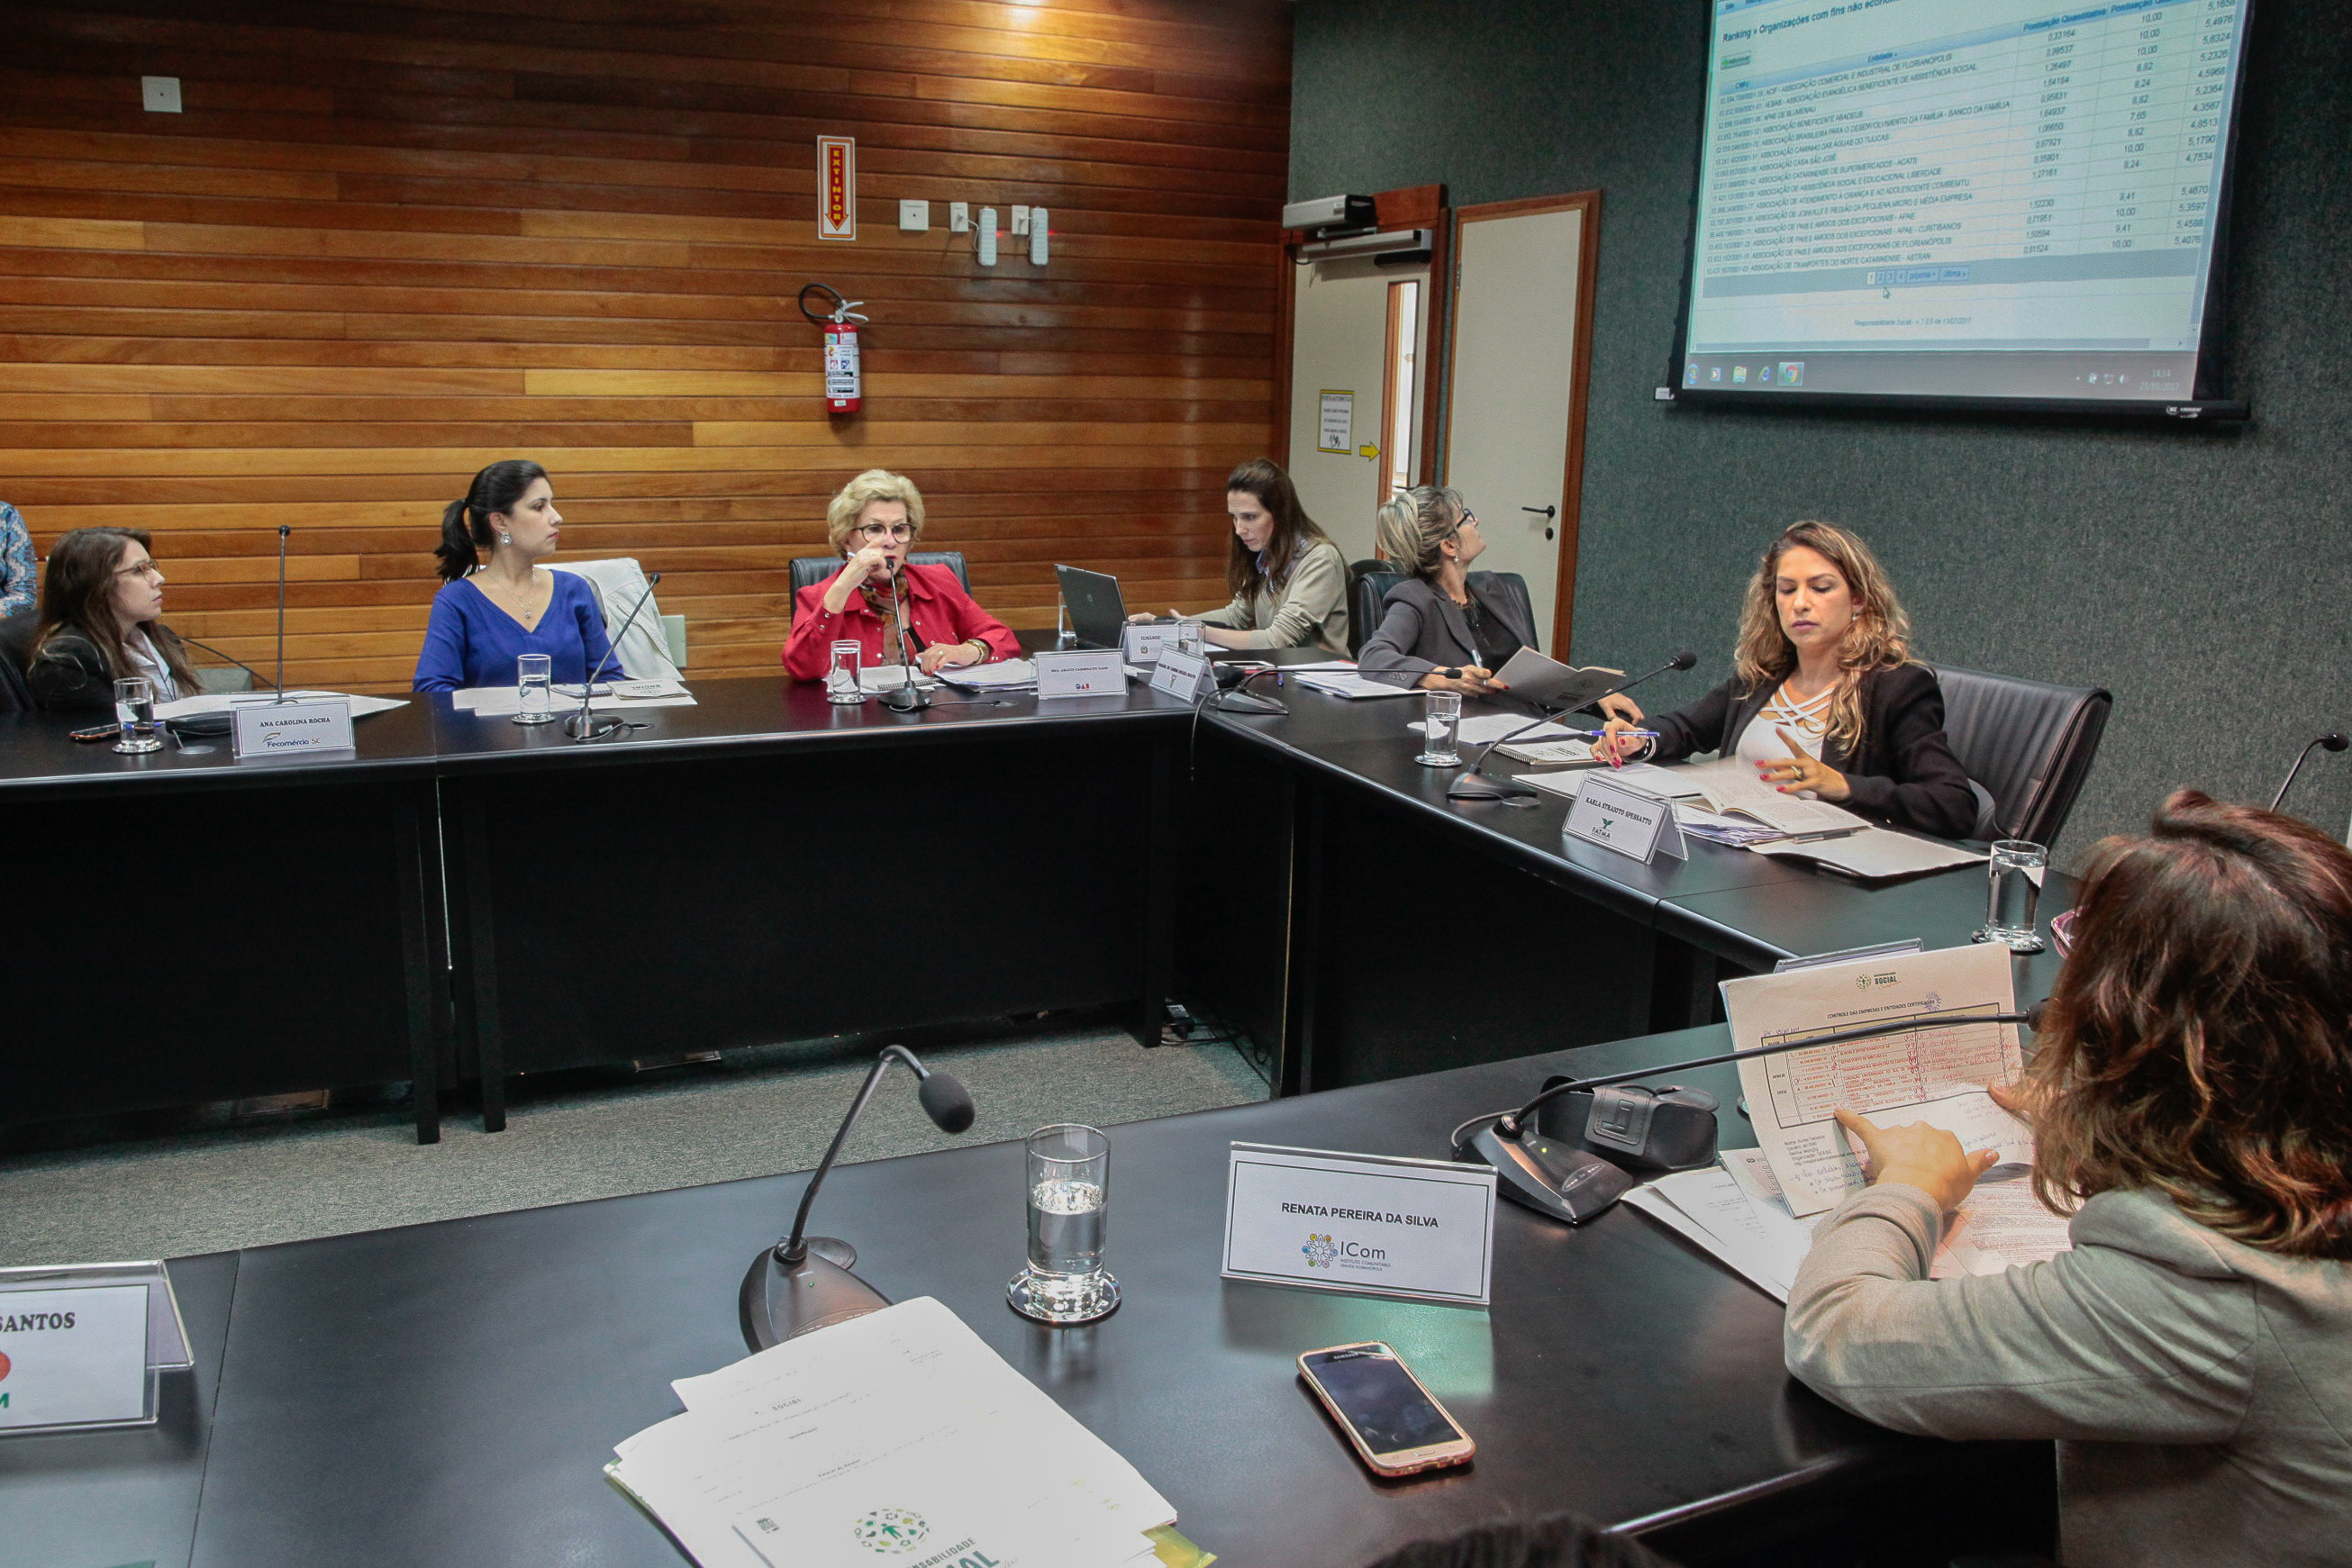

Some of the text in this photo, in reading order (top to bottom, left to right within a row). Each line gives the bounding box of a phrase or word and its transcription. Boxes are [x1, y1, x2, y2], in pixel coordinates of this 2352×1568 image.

[1722, 29, 1751, 42] Ranking
[1759, 15, 1809, 34] Organizações
[1812, 12, 1828, 22] com
[1830, 5, 1845, 16] fins
[2139, 28, 2159, 41] 10,00
[2204, 14, 2233, 29] 5,4976
[2141, 12, 2162, 24] 10,00
[2137, 45, 2157, 57] 10,00
[2202, 32, 2230, 46] 5,6324
[2136, 62, 2153, 73] 8,82
[2199, 49, 2229, 62] 5,2326
[2133, 78, 2151, 89] 8,24
[2197, 67, 2226, 79] 4,5968
[2131, 95, 2148, 105] 8,82
[2194, 84, 2223, 96] 5,2364
[2129, 111, 2147, 122] 7,65
[2192, 101, 2220, 113] 4,3567
[2127, 127, 2144, 138] 8,82
[2190, 117, 2218, 130] 4,8513
[2123, 143, 2144, 154] 10,00
[2187, 134, 2216, 147] 5,1790
[2122, 159, 2139, 169] 8,24
[2184, 151, 2213, 163] 4,7534
[832, 150, 841, 221] EXTINTOR
[2119, 192, 2135, 202] 9,41
[2180, 185, 2209, 195] 5,4670
[2115, 207, 2135, 217] 10,00
[2178, 201, 2206, 212] 5,3597
[2114, 223, 2131, 232] 9,41
[2175, 218, 2203, 228] 5,4588
[2111, 239, 2130, 249] 10,00
[2173, 234, 2201, 244] 5,4076
[267, 739, 310, 748] Fecomércio
[1585, 797, 1602, 808] KARLA
[1592, 827, 1611, 838] FATMA
[1874, 975, 1897, 985] SOCIAL
[1281, 1202, 1439, 1228] RENATA PEREIRA DA SILVA
[1340, 1241, 1385, 1260] ICom
[0, 1311, 76, 1332] ANTOS
